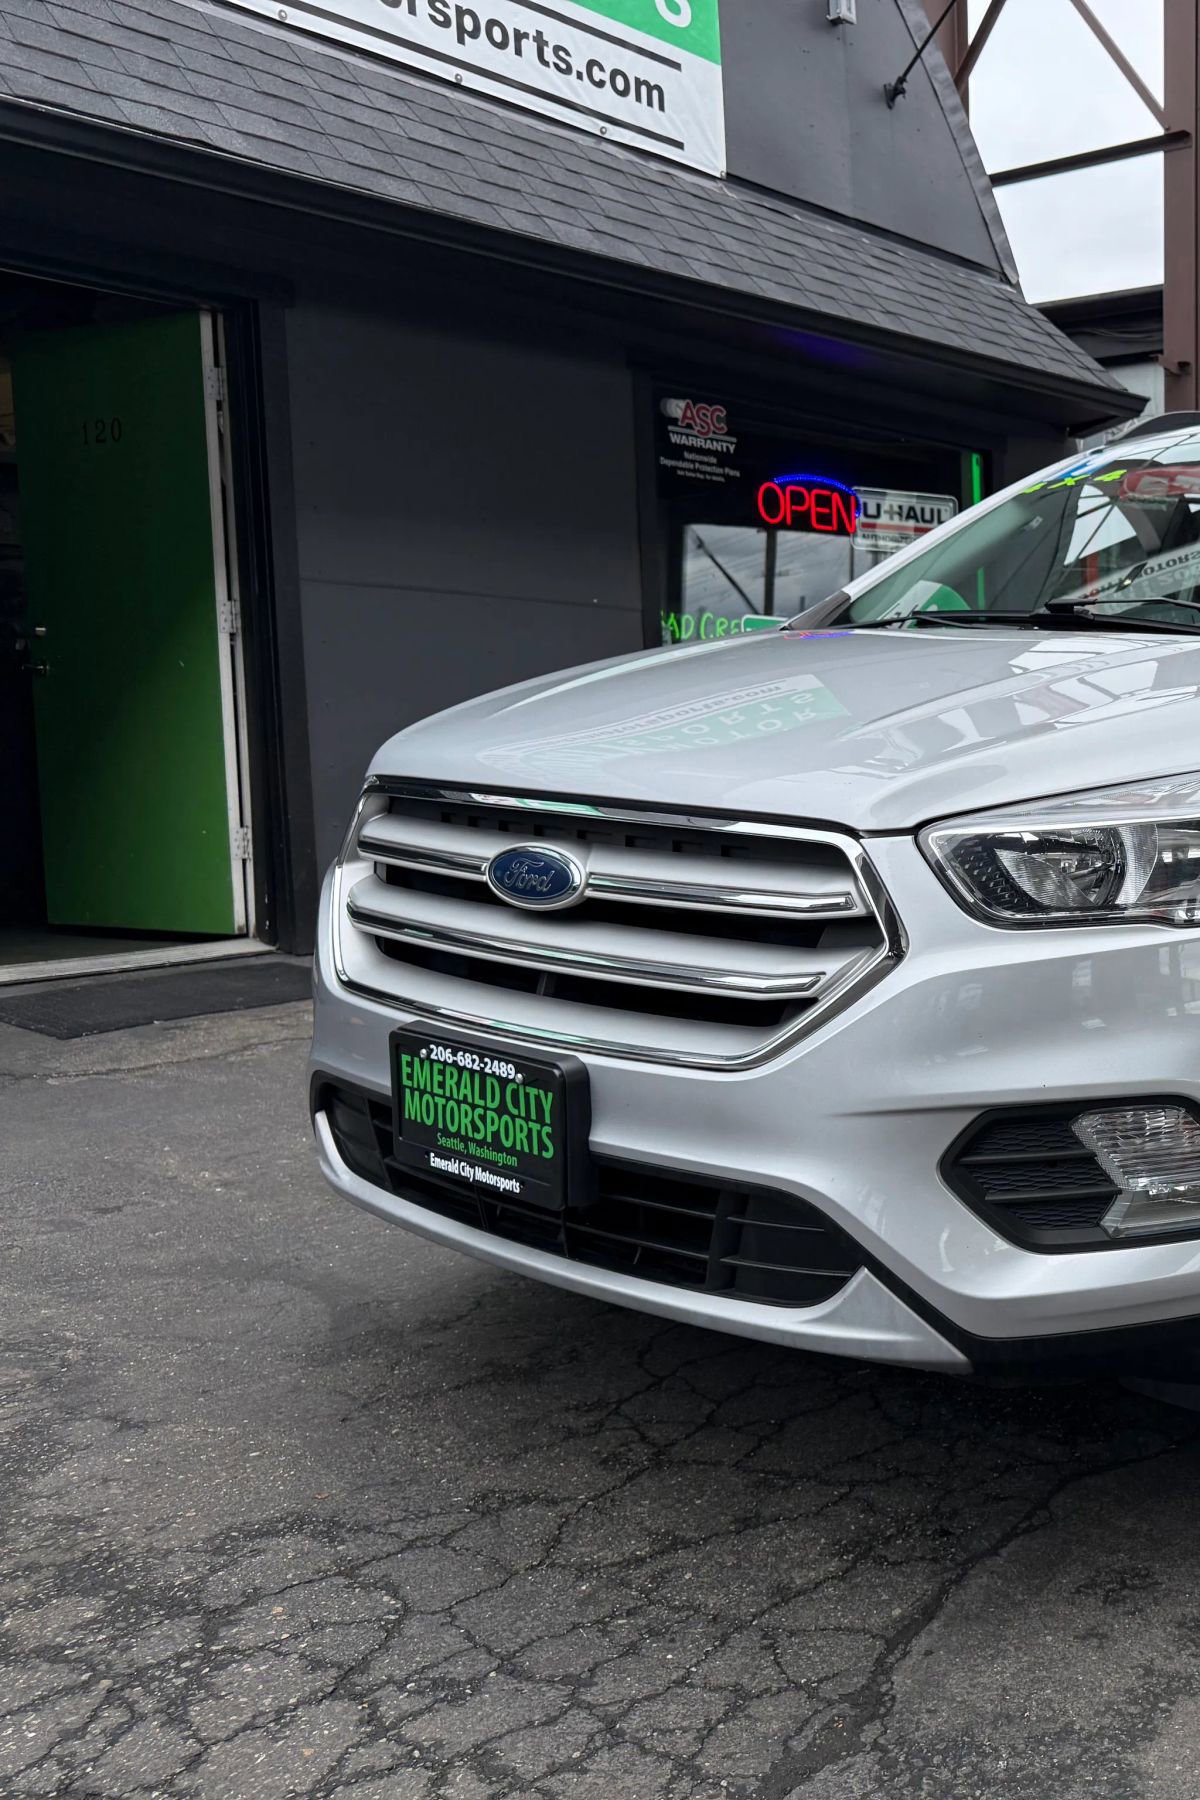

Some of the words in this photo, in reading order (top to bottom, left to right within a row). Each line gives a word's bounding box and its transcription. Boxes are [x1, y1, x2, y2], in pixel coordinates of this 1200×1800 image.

[81, 417, 123, 446] 120
[677, 399, 729, 439] ASC
[669, 431, 736, 455] WARRANTY
[757, 481, 856, 534] OPEN
[504, 857, 556, 892] Ford
[429, 1044, 516, 1080] 206-682-2489
[401, 1053, 501, 1109] EMERALD
[505, 1082, 553, 1124] CITY
[404, 1088, 554, 1159] MOTORSPORTS
[437, 1132, 467, 1154] Seattle,
[468, 1141, 518, 1167] Washington
[430, 1152, 459, 1175] Emerald
[460, 1161, 475, 1182] City
[475, 1166, 521, 1194] Motorsports
